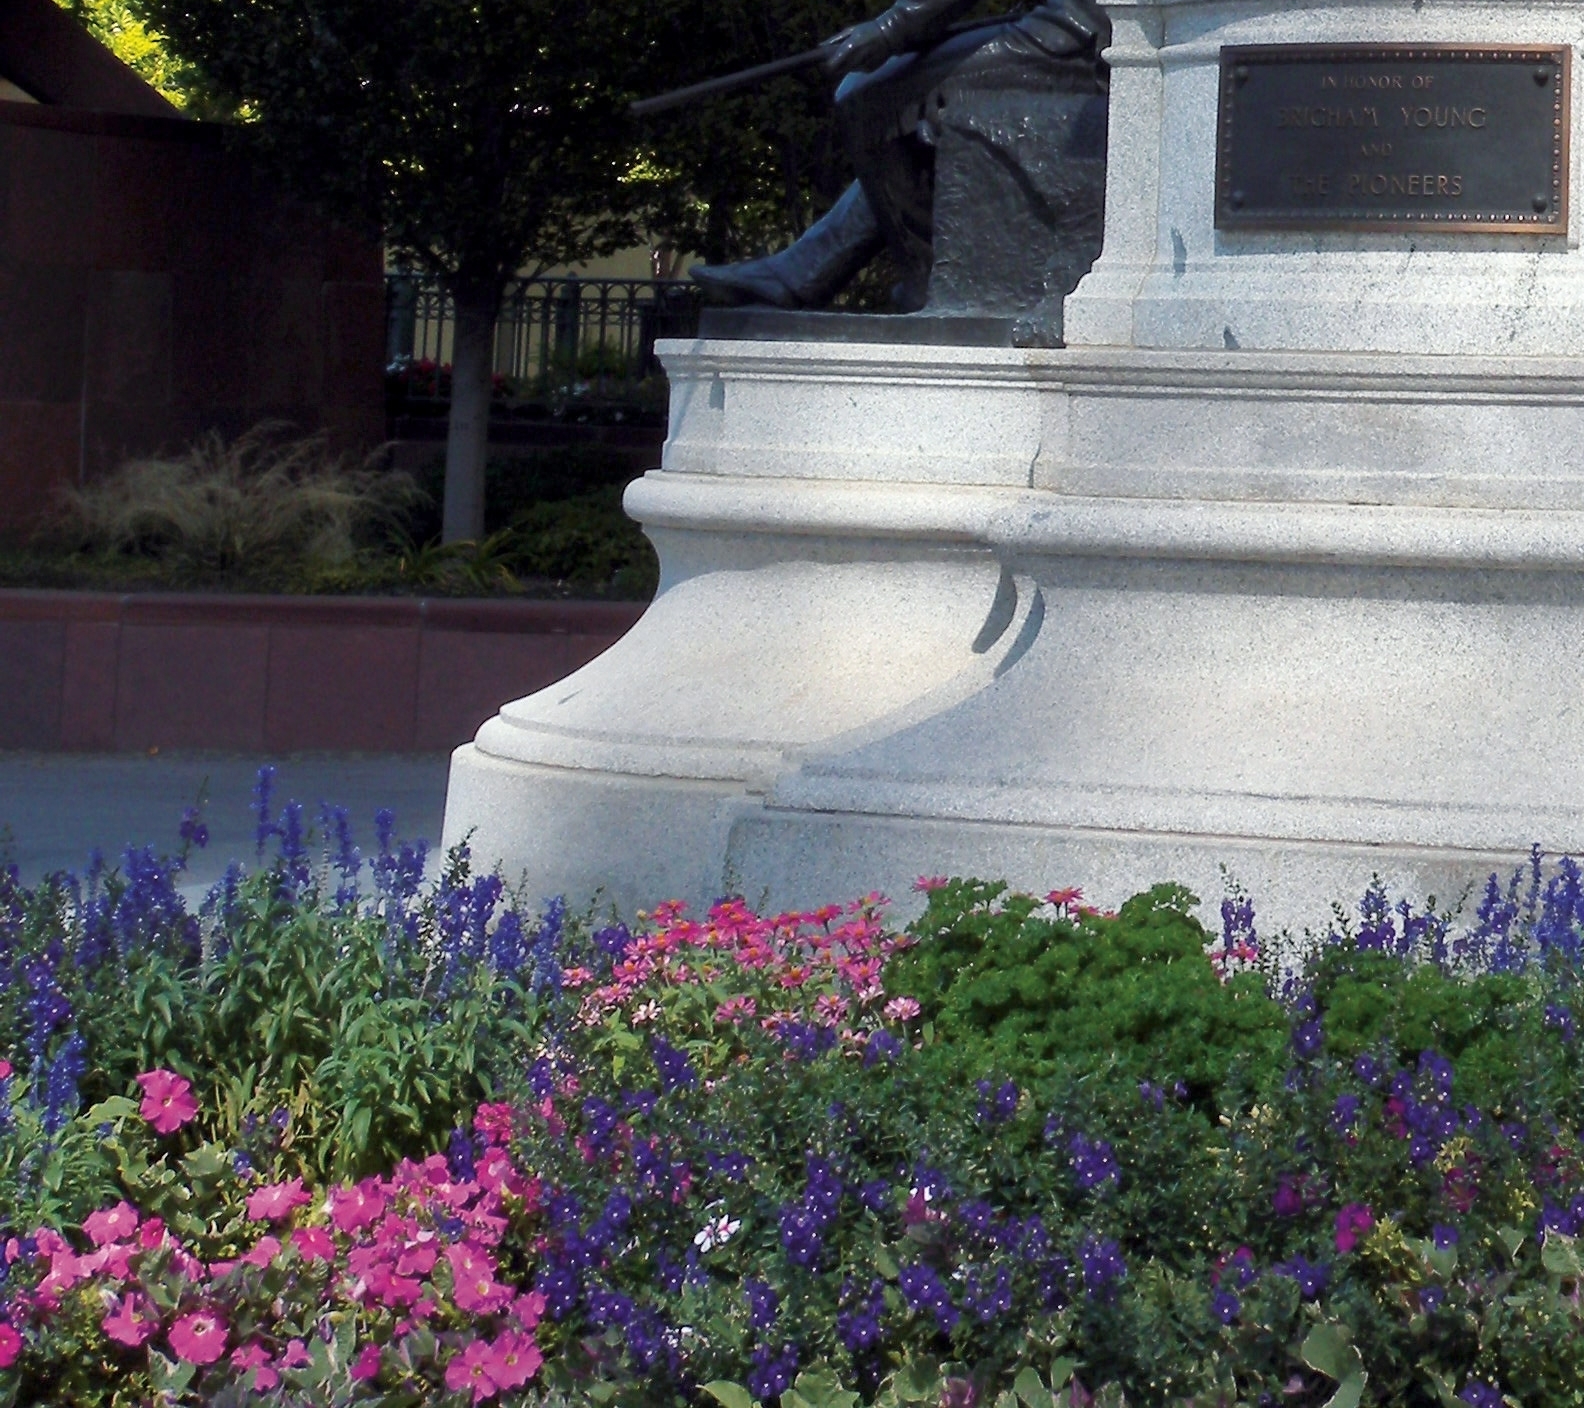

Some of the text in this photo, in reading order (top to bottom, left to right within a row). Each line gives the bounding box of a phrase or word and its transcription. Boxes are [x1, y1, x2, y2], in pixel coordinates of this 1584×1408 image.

[1321, 75, 1435, 89] IN HONOR OF
[1276, 106, 1488, 129] BRIGHAM YOUNG
[1360, 143, 1394, 157] AND
[1291, 174, 1464, 197] THE PIONEERS
